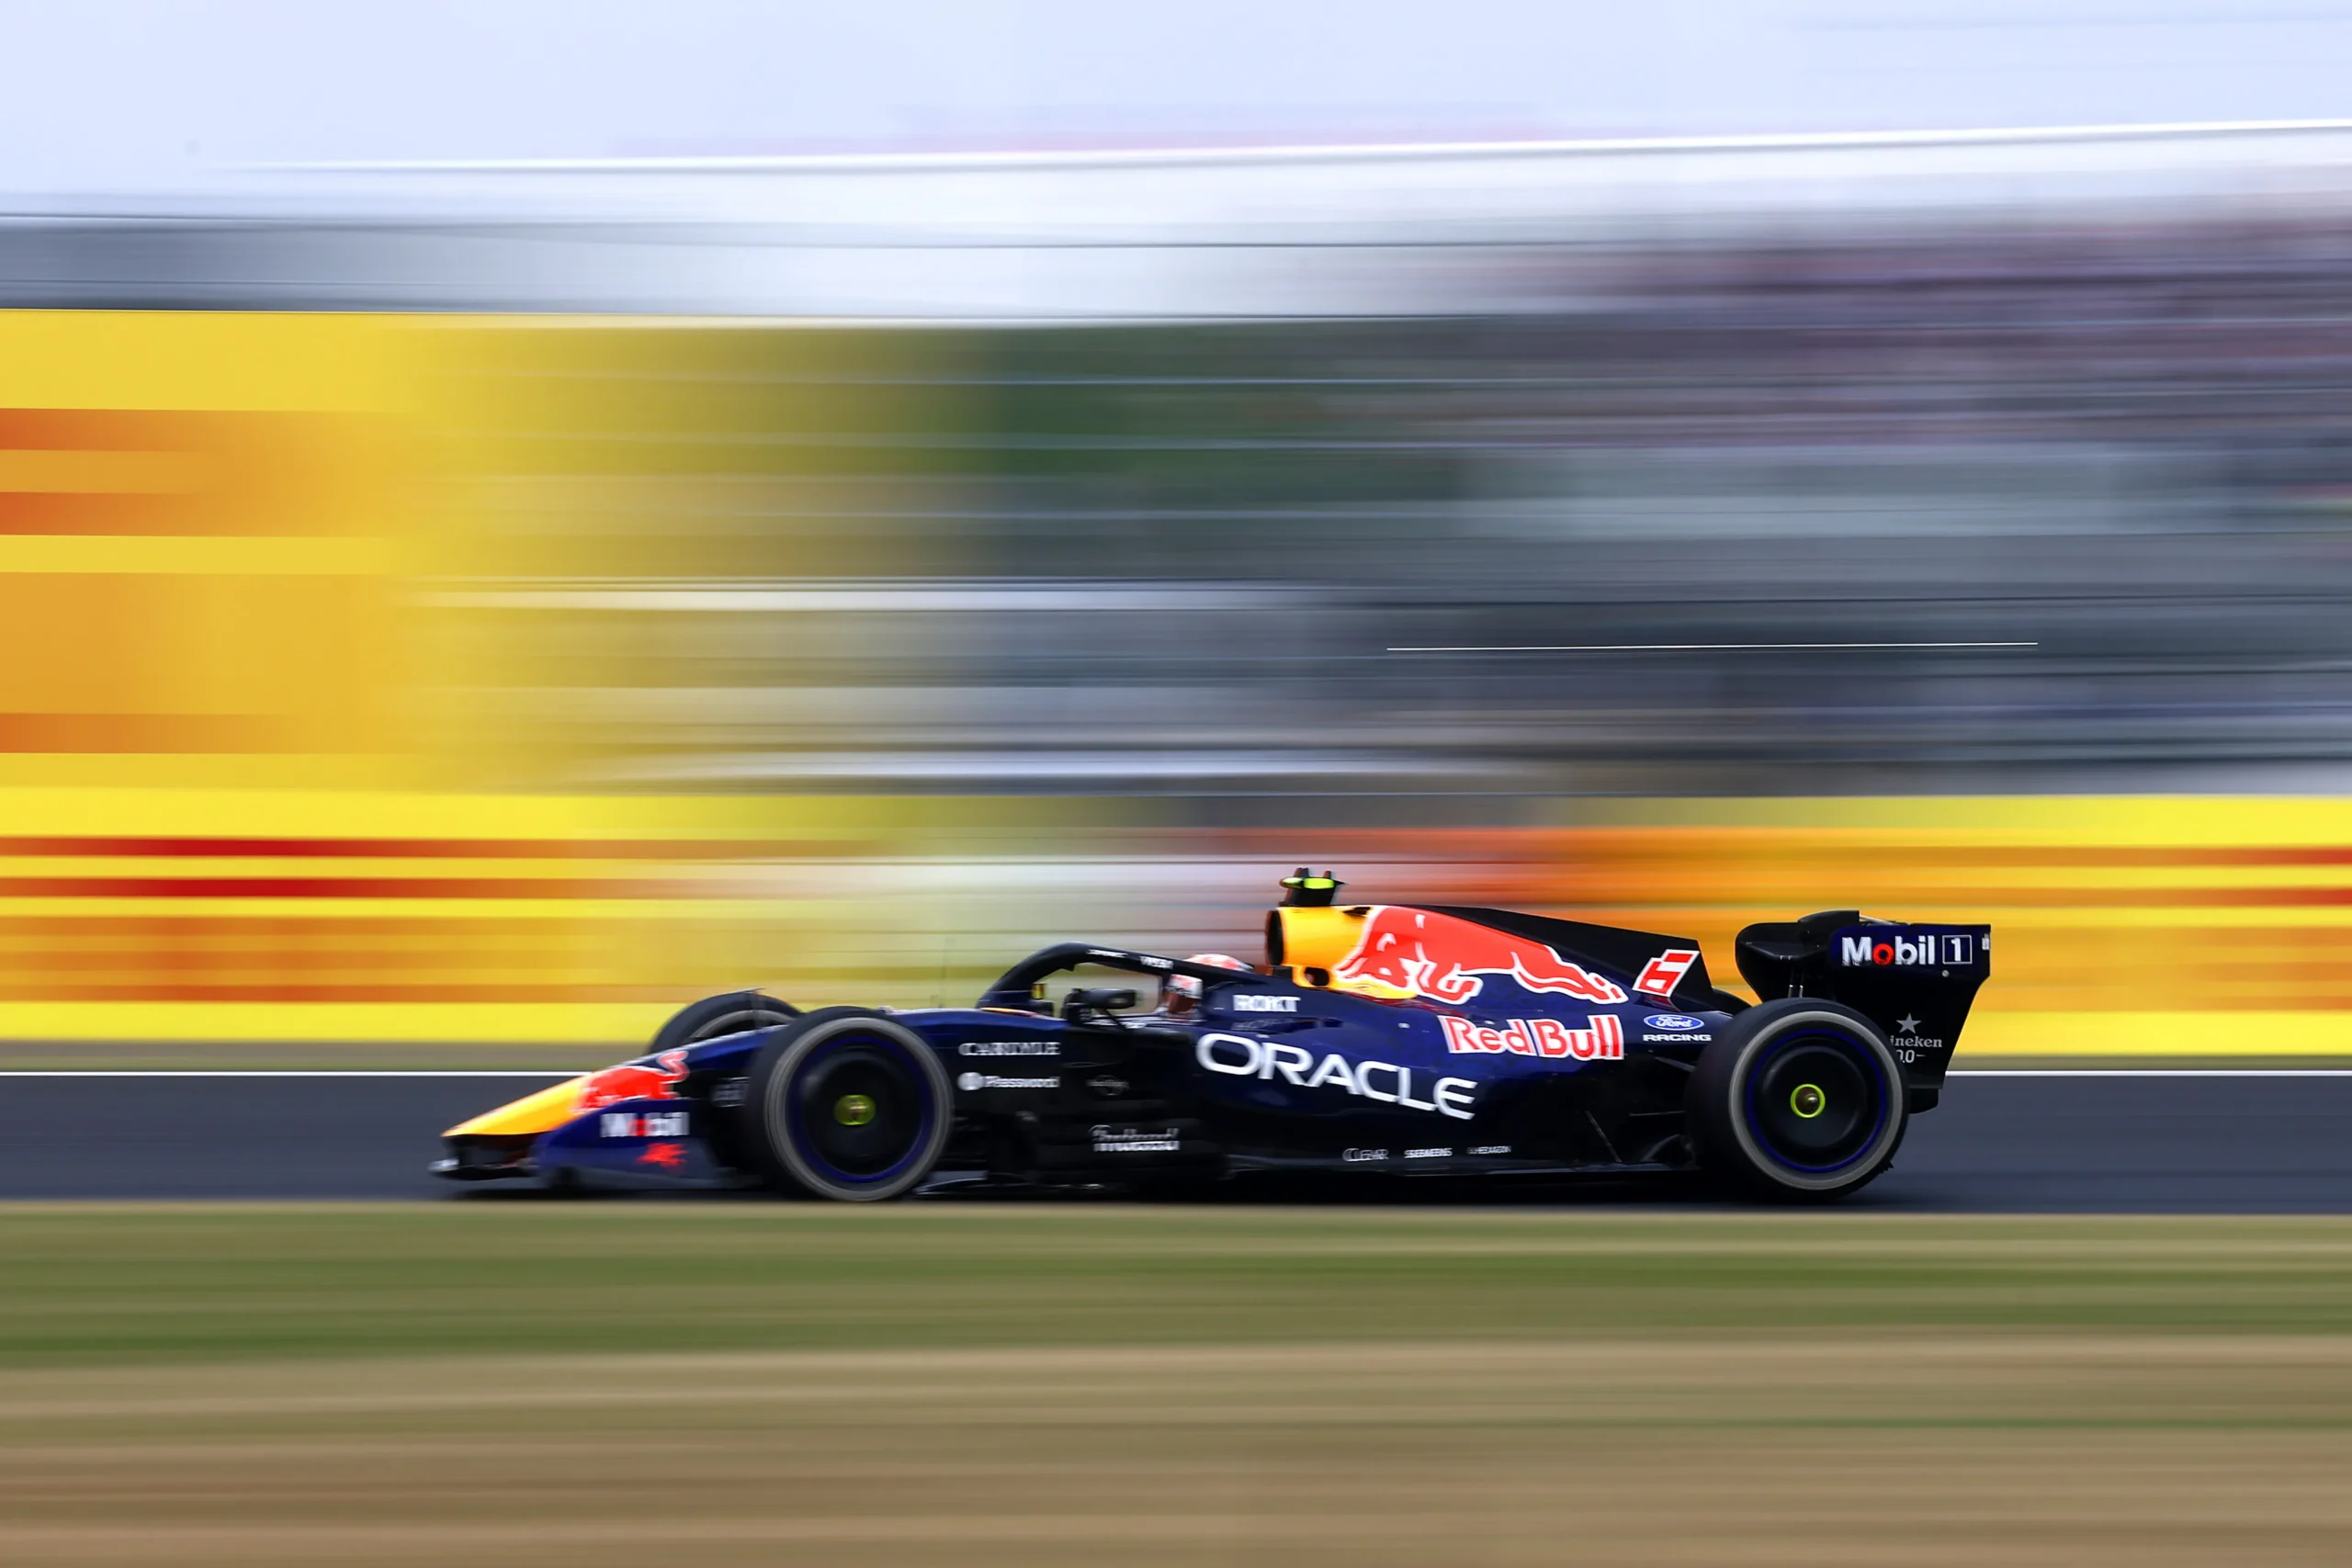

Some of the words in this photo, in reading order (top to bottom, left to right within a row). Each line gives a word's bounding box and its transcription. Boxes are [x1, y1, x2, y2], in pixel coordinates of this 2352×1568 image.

[1842, 935, 1935, 966] Mobil
[1633, 949, 1700, 998] 6
[1440, 1015, 1536, 1055] Red
[1529, 1014, 1623, 1060] Bull
[1655, 1016, 1693, 1028] Ford
[1890, 1036, 1942, 1048] ineken
[1196, 1032, 1477, 1120] ORACLE
